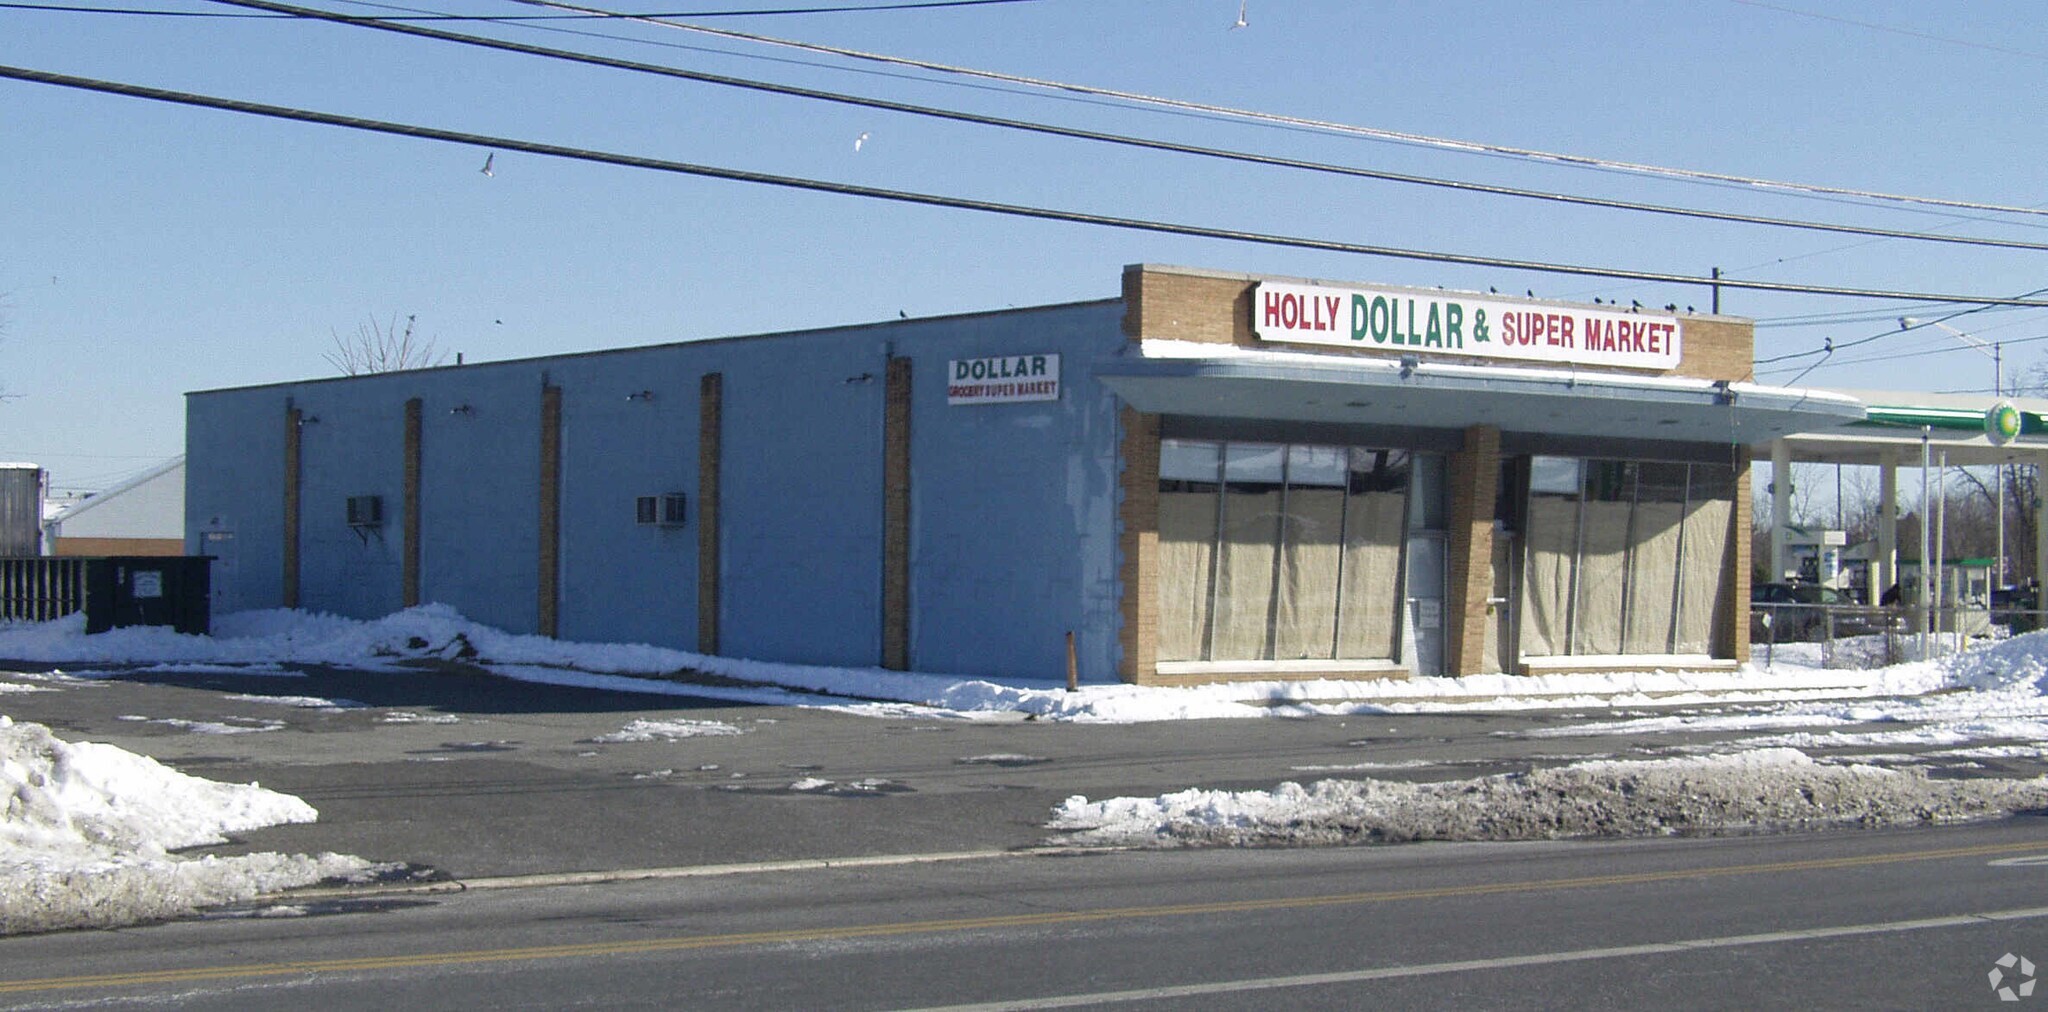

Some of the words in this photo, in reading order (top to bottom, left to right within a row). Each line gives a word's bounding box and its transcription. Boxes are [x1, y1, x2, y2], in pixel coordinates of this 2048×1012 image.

[1264, 291, 1341, 331] HOLLY
[1351, 293, 1463, 349] DOLLAR
[1473, 308, 1490, 342] &
[1502, 311, 1574, 349] SUPER
[1585, 318, 1675, 355] MARKET
[956, 356, 1046, 380] DOLLAR
[985, 382, 1015, 397] SUPER
[1017, 381, 1057, 396] MARKET
